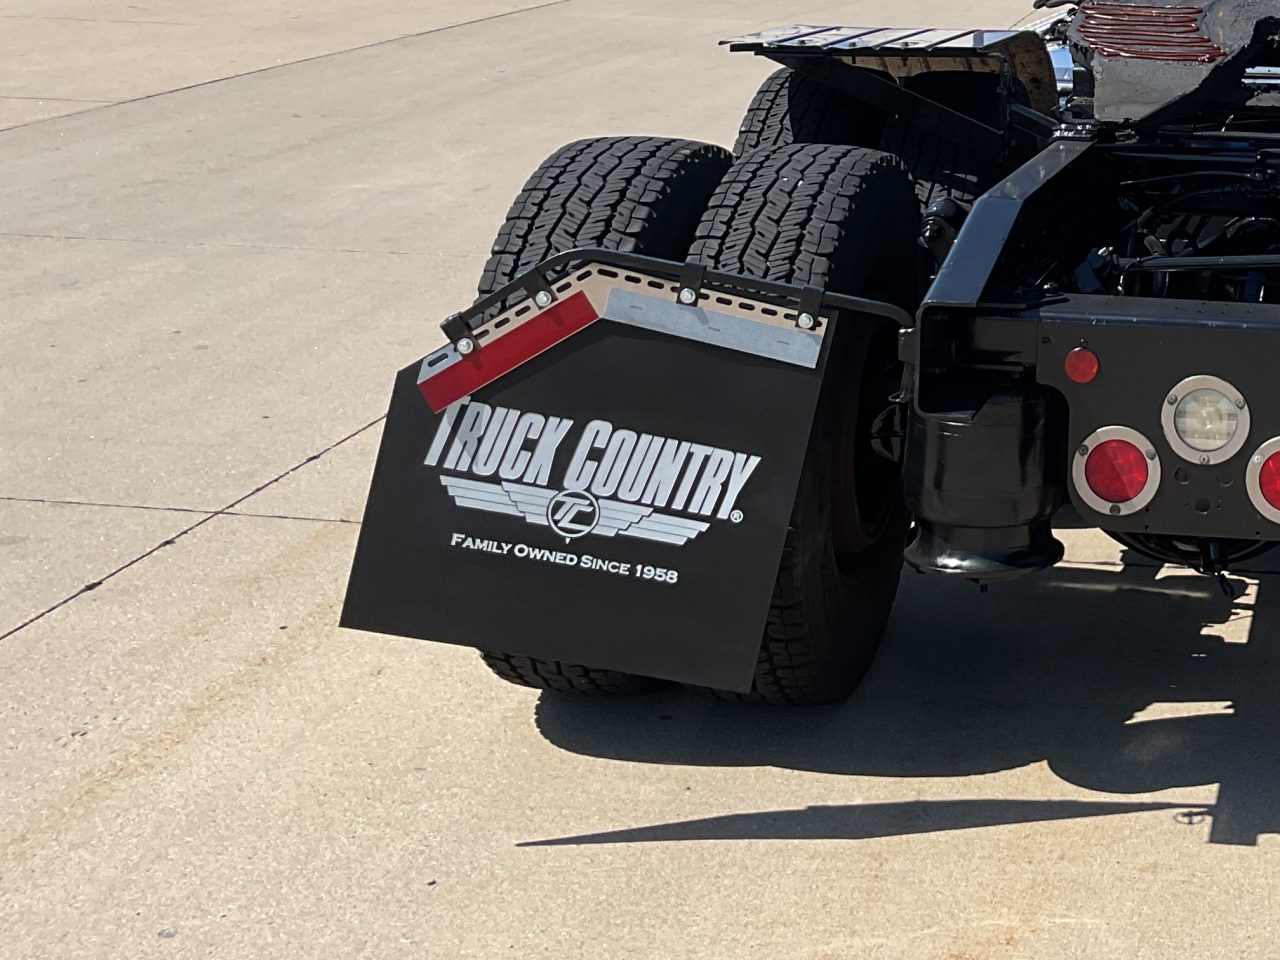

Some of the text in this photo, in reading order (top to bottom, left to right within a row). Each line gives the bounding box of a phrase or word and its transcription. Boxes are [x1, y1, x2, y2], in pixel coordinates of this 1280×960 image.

[424, 395, 574, 486] TRUCK
[450, 532, 679, 583] FAMILY OWNED SINCE 1958
